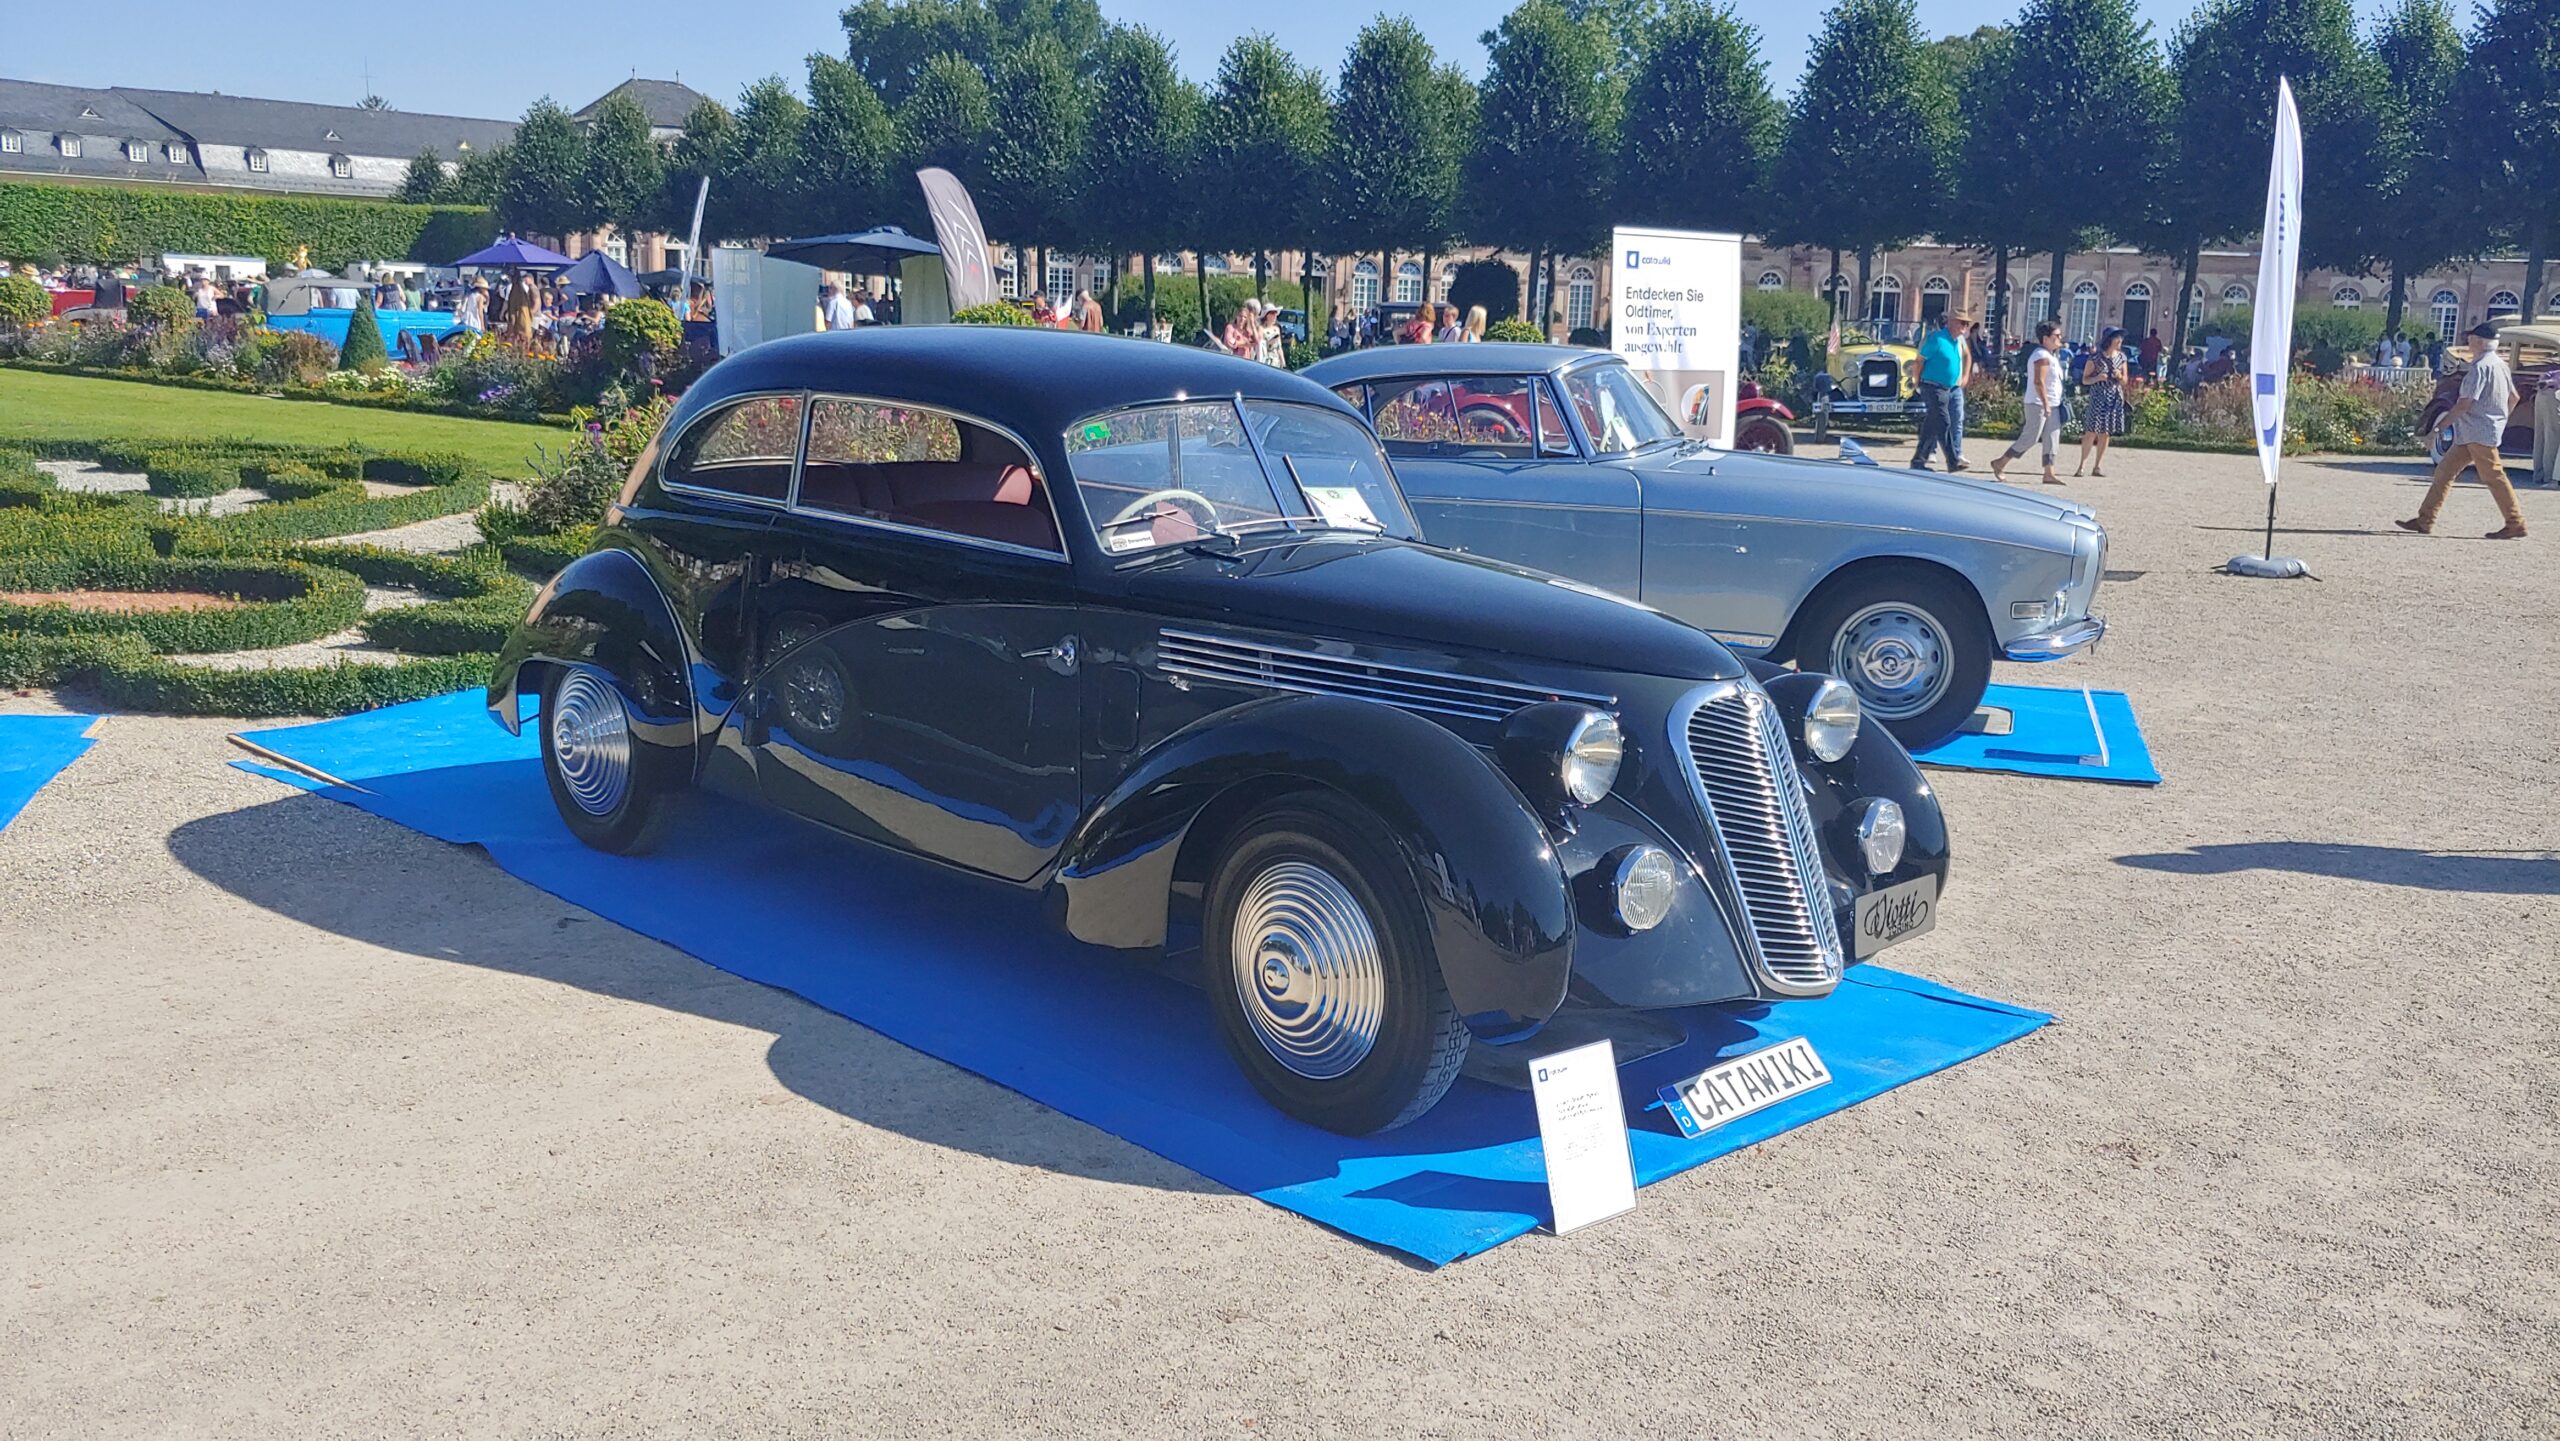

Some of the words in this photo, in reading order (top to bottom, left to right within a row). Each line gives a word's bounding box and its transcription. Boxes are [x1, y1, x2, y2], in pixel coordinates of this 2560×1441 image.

[1626, 286, 1683, 301] Entdecken
[1686, 288, 1704, 302] Sie
[1625, 304, 1674, 320] Oldtimer,
[1625, 325, 1644, 335] von
[1647, 322, 1697, 340] Experten
[1864, 890, 1928, 939] Viotti
[1682, 1044, 1824, 1121] CATAWIKI
[1681, 1116, 1692, 1128] D
